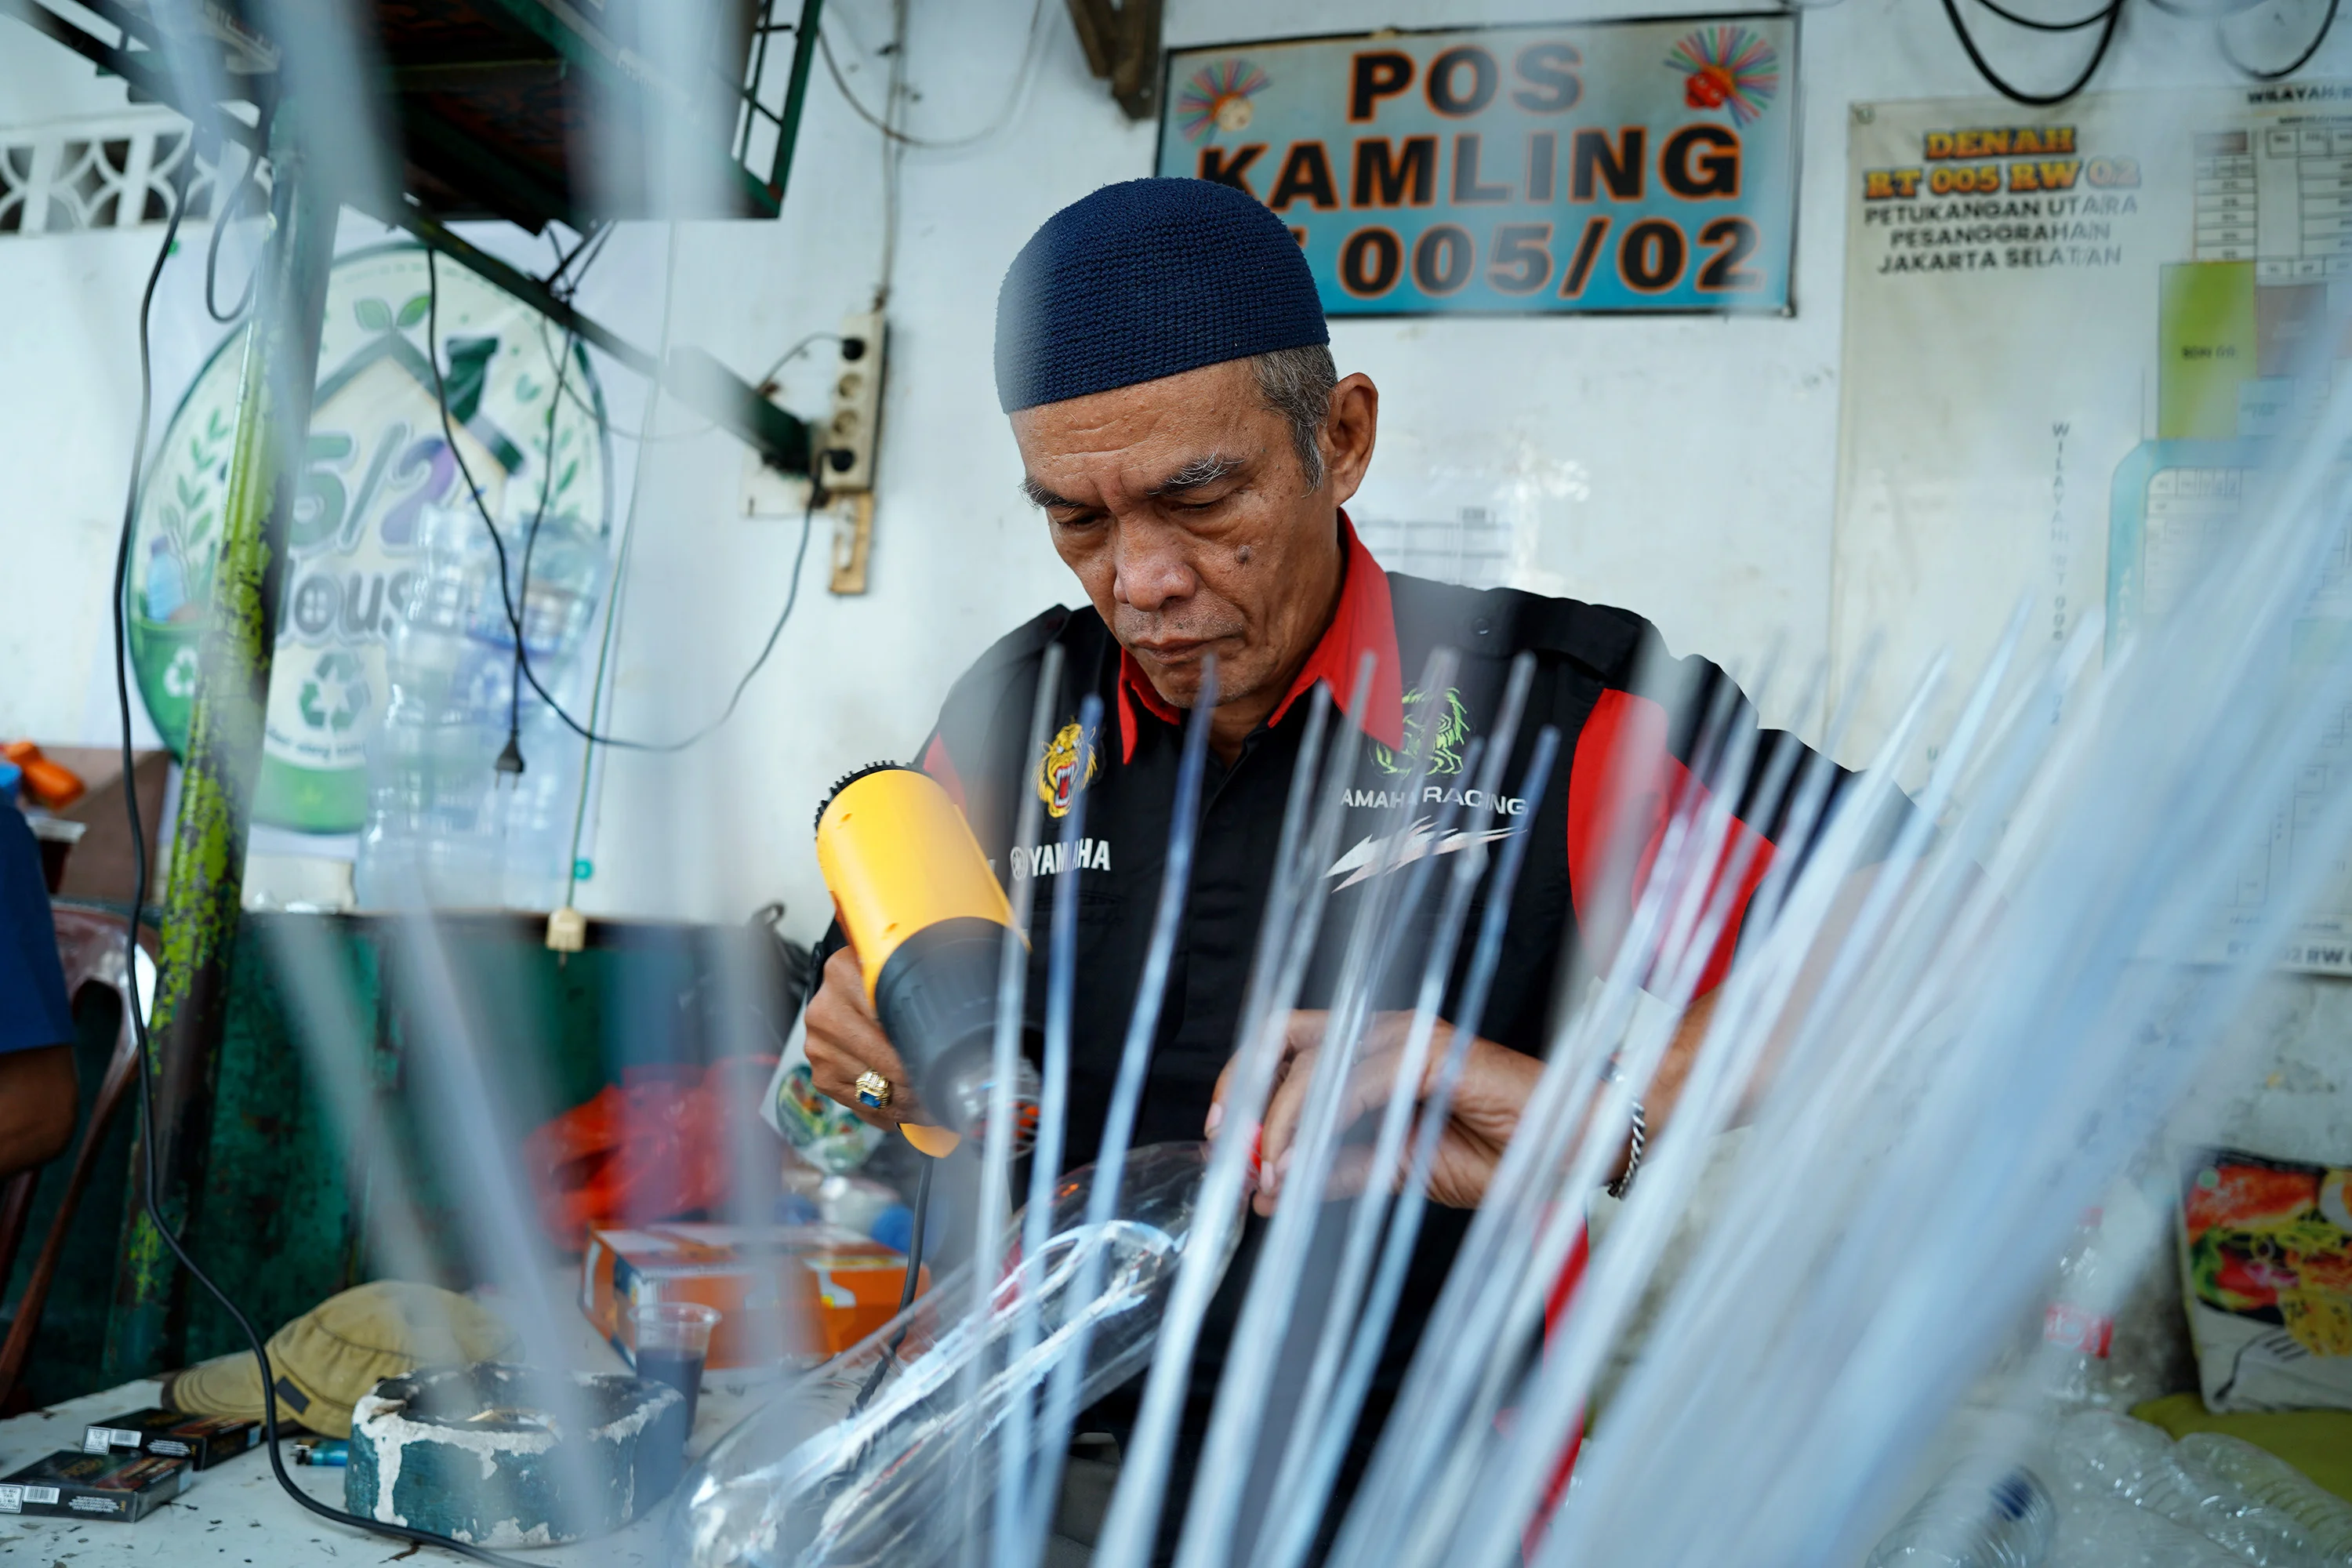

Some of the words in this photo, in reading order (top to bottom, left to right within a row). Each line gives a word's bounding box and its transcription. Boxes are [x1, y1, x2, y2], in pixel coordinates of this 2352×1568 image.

[1348, 42, 1585, 124] POS
[1924, 125, 2077, 162] DENAH
[1197, 124, 1743, 212] KAMLING
[1863, 167, 1923, 201] RT
[1929, 163, 2002, 194] 005
[2007, 158, 2082, 193] RW
[2086, 158, 2142, 189] 02
[1864, 198, 2040, 227] PETUKANGAN
[2047, 194, 2140, 217] UTARA
[1338, 214, 1764, 299] 005/02
[1876, 249, 1998, 275] JAKARTA
[2004, 245, 2123, 269] SELATAN
[1340, 786, 1418, 809] AMAHA
[1422, 786, 1527, 815] RACING
[1029, 837, 1111, 877] YAMAHA
